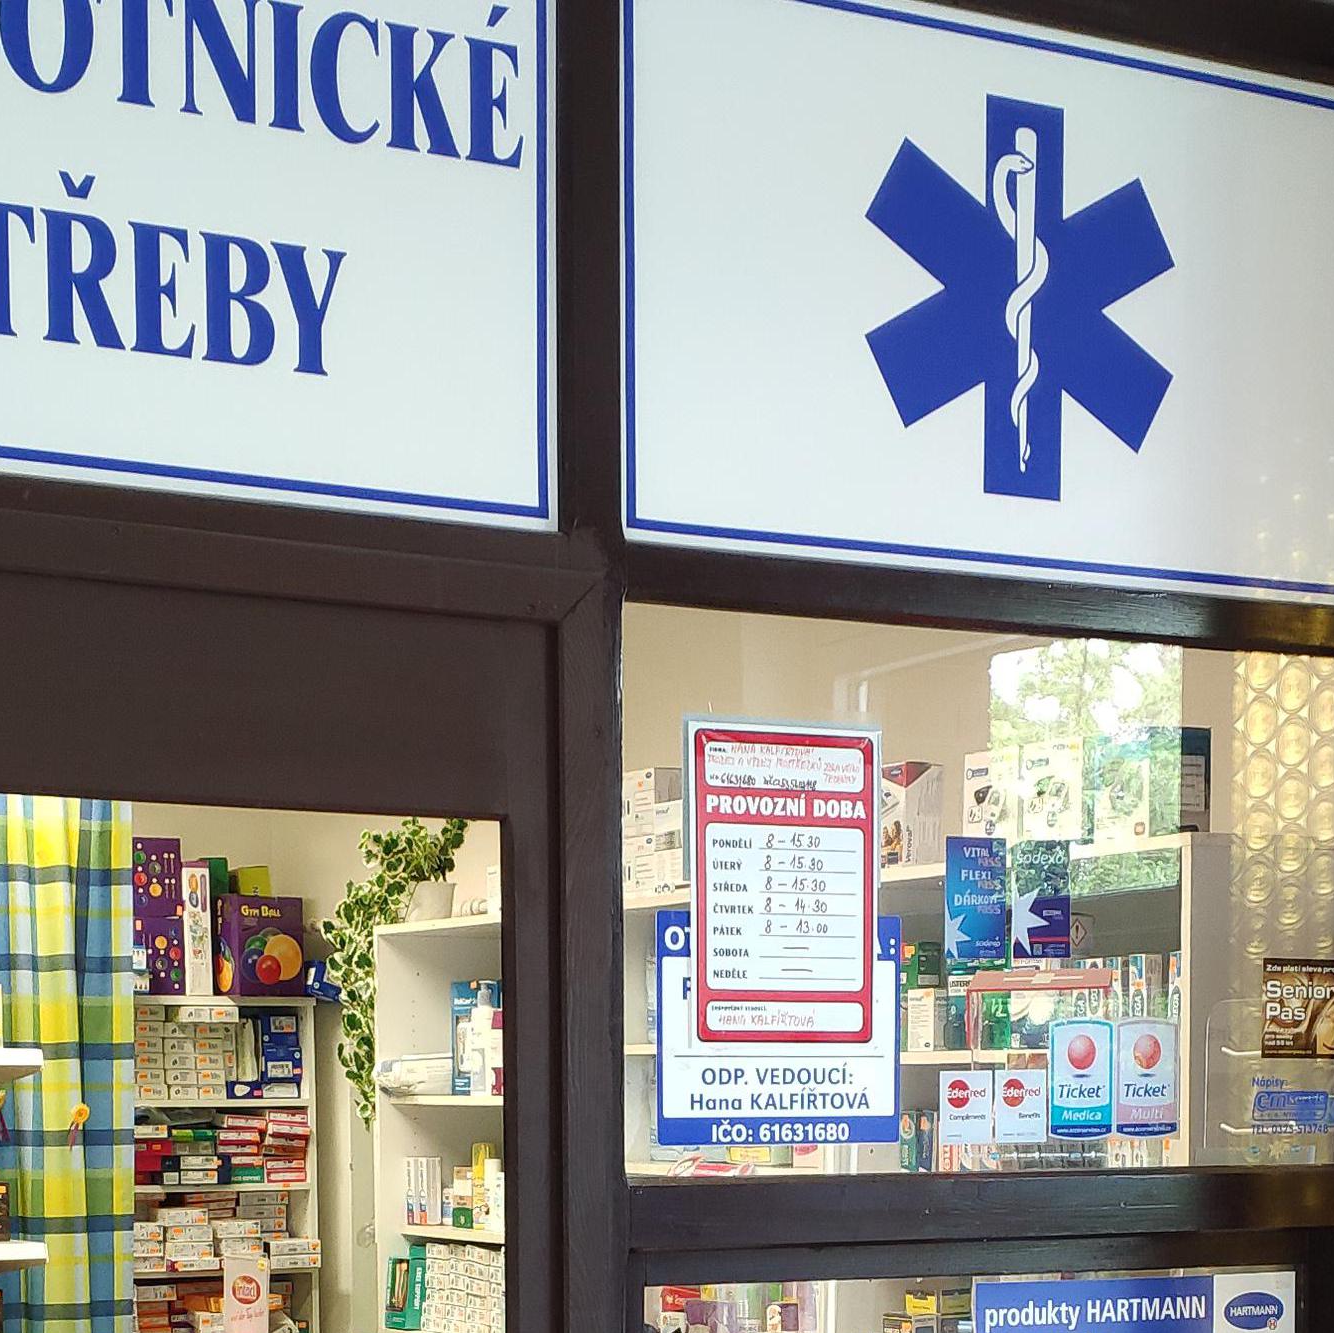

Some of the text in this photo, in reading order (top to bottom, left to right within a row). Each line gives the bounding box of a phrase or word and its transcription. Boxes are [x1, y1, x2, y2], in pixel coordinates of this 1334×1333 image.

[706, 793, 867, 819] PROVOZNÍ DOBA
[712, 838, 752, 849] PONDĚLÍ
[766, 833, 774, 849] 8
[963, 846, 989, 858] VITAL
[1017, 846, 1067, 864] sodexo
[713, 858, 742, 871] ÚTERÝ
[765, 855, 772, 871] 8
[961, 870, 991, 881] FLEXI
[712, 882, 748, 892] STŘEDA
[765, 876, 772, 891] 8
[713, 903, 754, 914] ČTVRTEK
[765, 897, 772, 913] 8
[713, 925, 742, 936] PÁTEK
[765, 919, 772, 934] 8
[713, 948, 749, 957] SOBOTA
[713, 969, 747, 979] NEDĚLE
[1302, 965, 1322, 973] sleva
[1266, 1002, 1306, 1021] Pas
[702, 1062, 853, 1086] ODP. VEDOUCÍ:
[947, 1085, 987, 1099] Edenred
[1002, 1084, 1041, 1098] Edenred
[1058, 1084, 1103, 1099] Ticket
[1124, 1083, 1167, 1098] Ticket
[690, 1087, 870, 1110] Hana KALFÍŘTOVÁ
[1018, 1112, 1041, 1120] Benefits
[1061, 1109, 1102, 1121] Medica
[1130, 1108, 1164, 1120] Multi
[711, 1119, 850, 1143] IČO: 61631680
[984, 1295, 1207, 1332] produkty HARTMANN
[1230, 1305, 1278, 1317] HARTMANN
